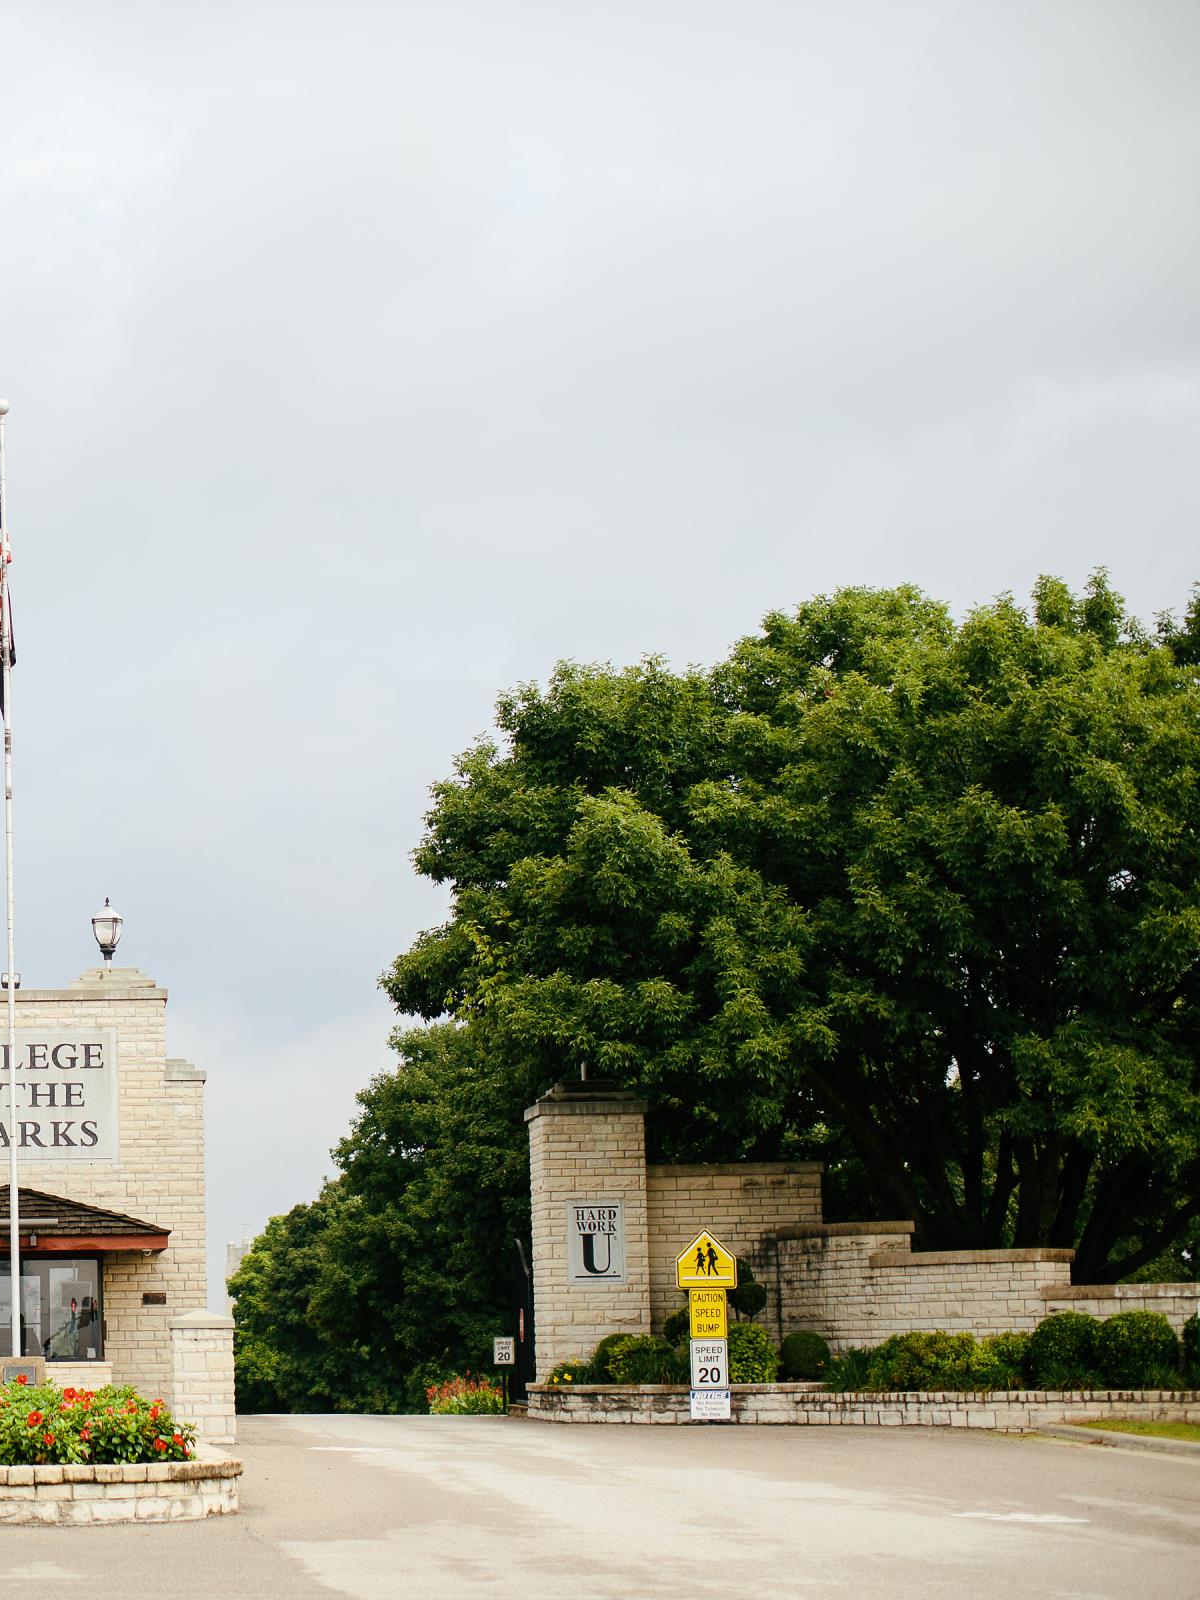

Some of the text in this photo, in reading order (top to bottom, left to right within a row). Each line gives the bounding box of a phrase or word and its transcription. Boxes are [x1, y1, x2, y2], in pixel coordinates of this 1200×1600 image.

[0, 1082, 85, 1108] THE
[575, 1209, 617, 1221] HARD
[575, 1220, 617, 1232] WORK
[692, 1293, 724, 1303] CAUTION
[695, 1308, 721, 1318] SPEED
[697, 1323, 720, 1333] BUMP
[695, 1346, 723, 1354] SPEED
[497, 1351, 511, 1362] 20
[698, 1355, 720, 1363] LIMIT
[698, 1367, 721, 1383] 20
[694, 1391, 727, 1399] NOTICE
